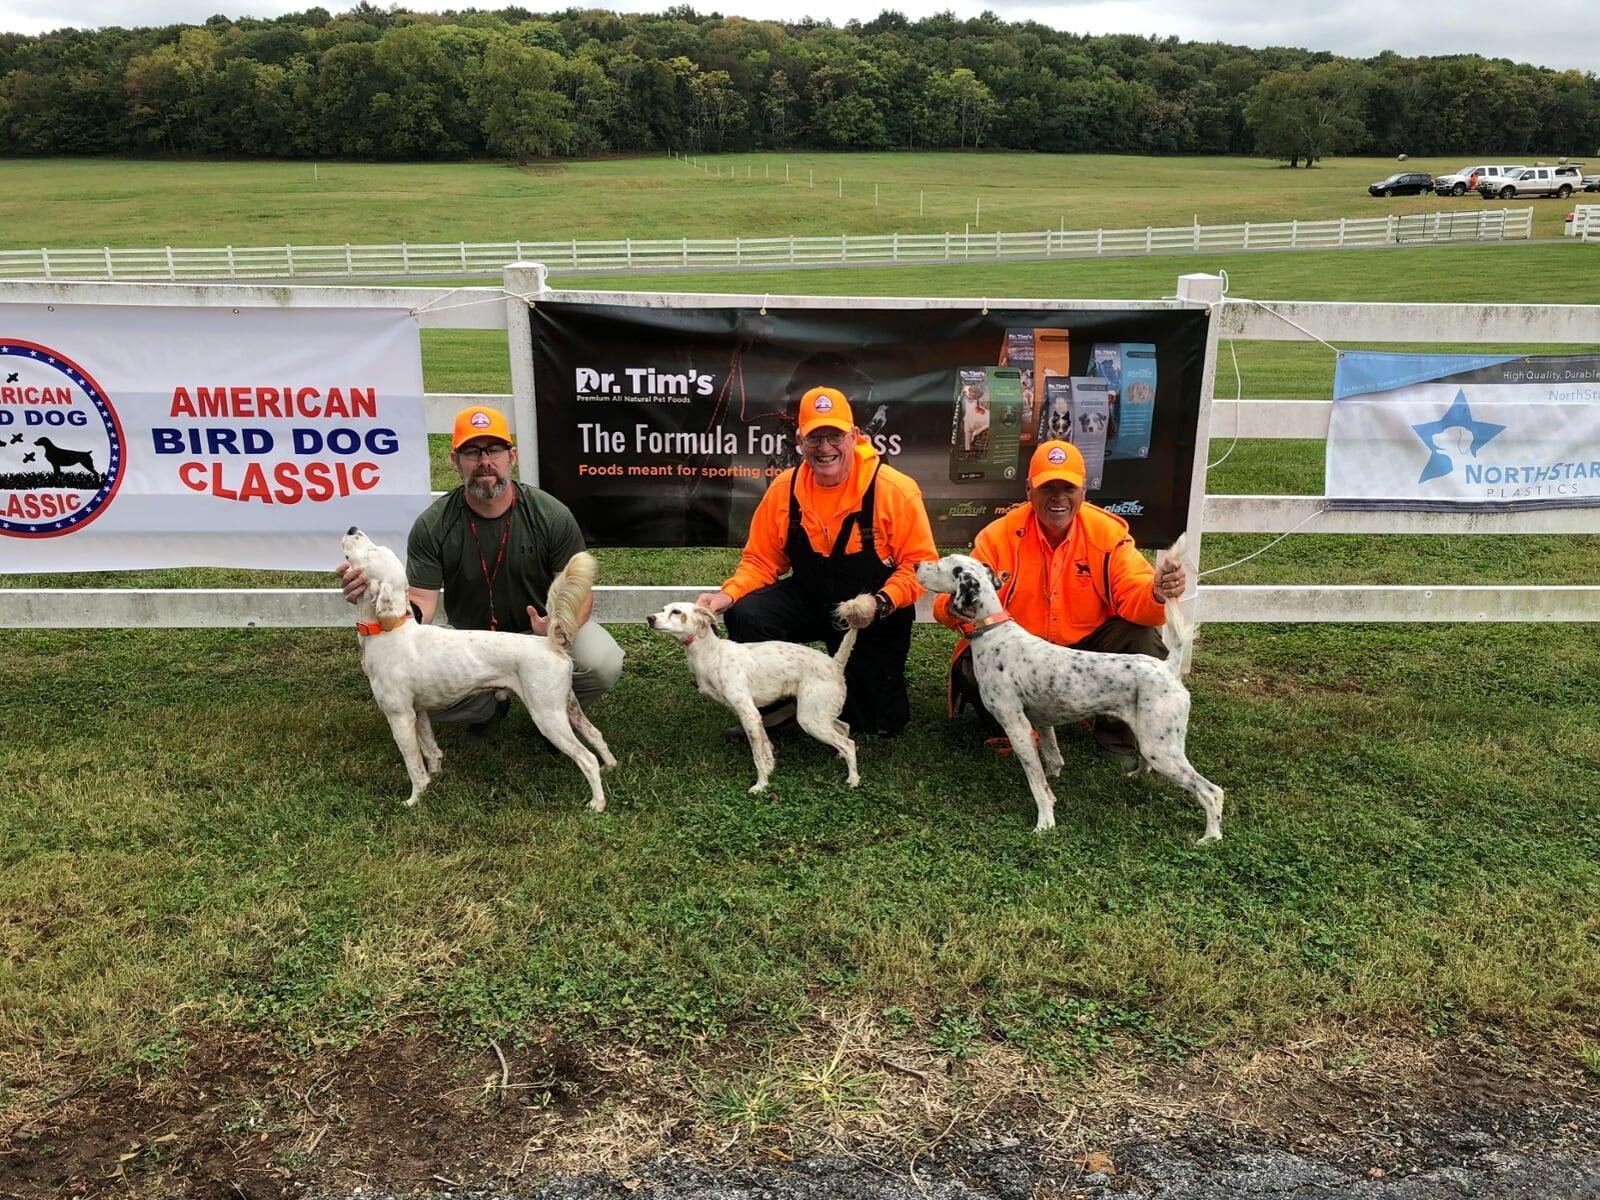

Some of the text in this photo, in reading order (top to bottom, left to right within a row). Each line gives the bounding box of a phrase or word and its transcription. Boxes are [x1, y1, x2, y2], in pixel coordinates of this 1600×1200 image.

[576, 368, 714, 396] Dr. Tim's
[1503, 368, 1600, 382] High Quality, Durable
[0, 387, 72, 405] RICAN
[170, 387, 377, 417] AMERICAN
[624, 395, 651, 403] Natural
[667, 396, 690, 404] Foods
[24, 410, 88, 426] DOG
[151, 428, 399, 455] BIRD DOG
[577, 423, 626, 453] The
[635, 424, 737, 454] Formula
[748, 425, 787, 455] For
[579, 464, 784, 478] Foods meant for sporting do
[178, 462, 381, 505] CLASSIC
[1487, 483, 1579, 498] PLASTICS
[0, 493, 81, 519] ASSIC
